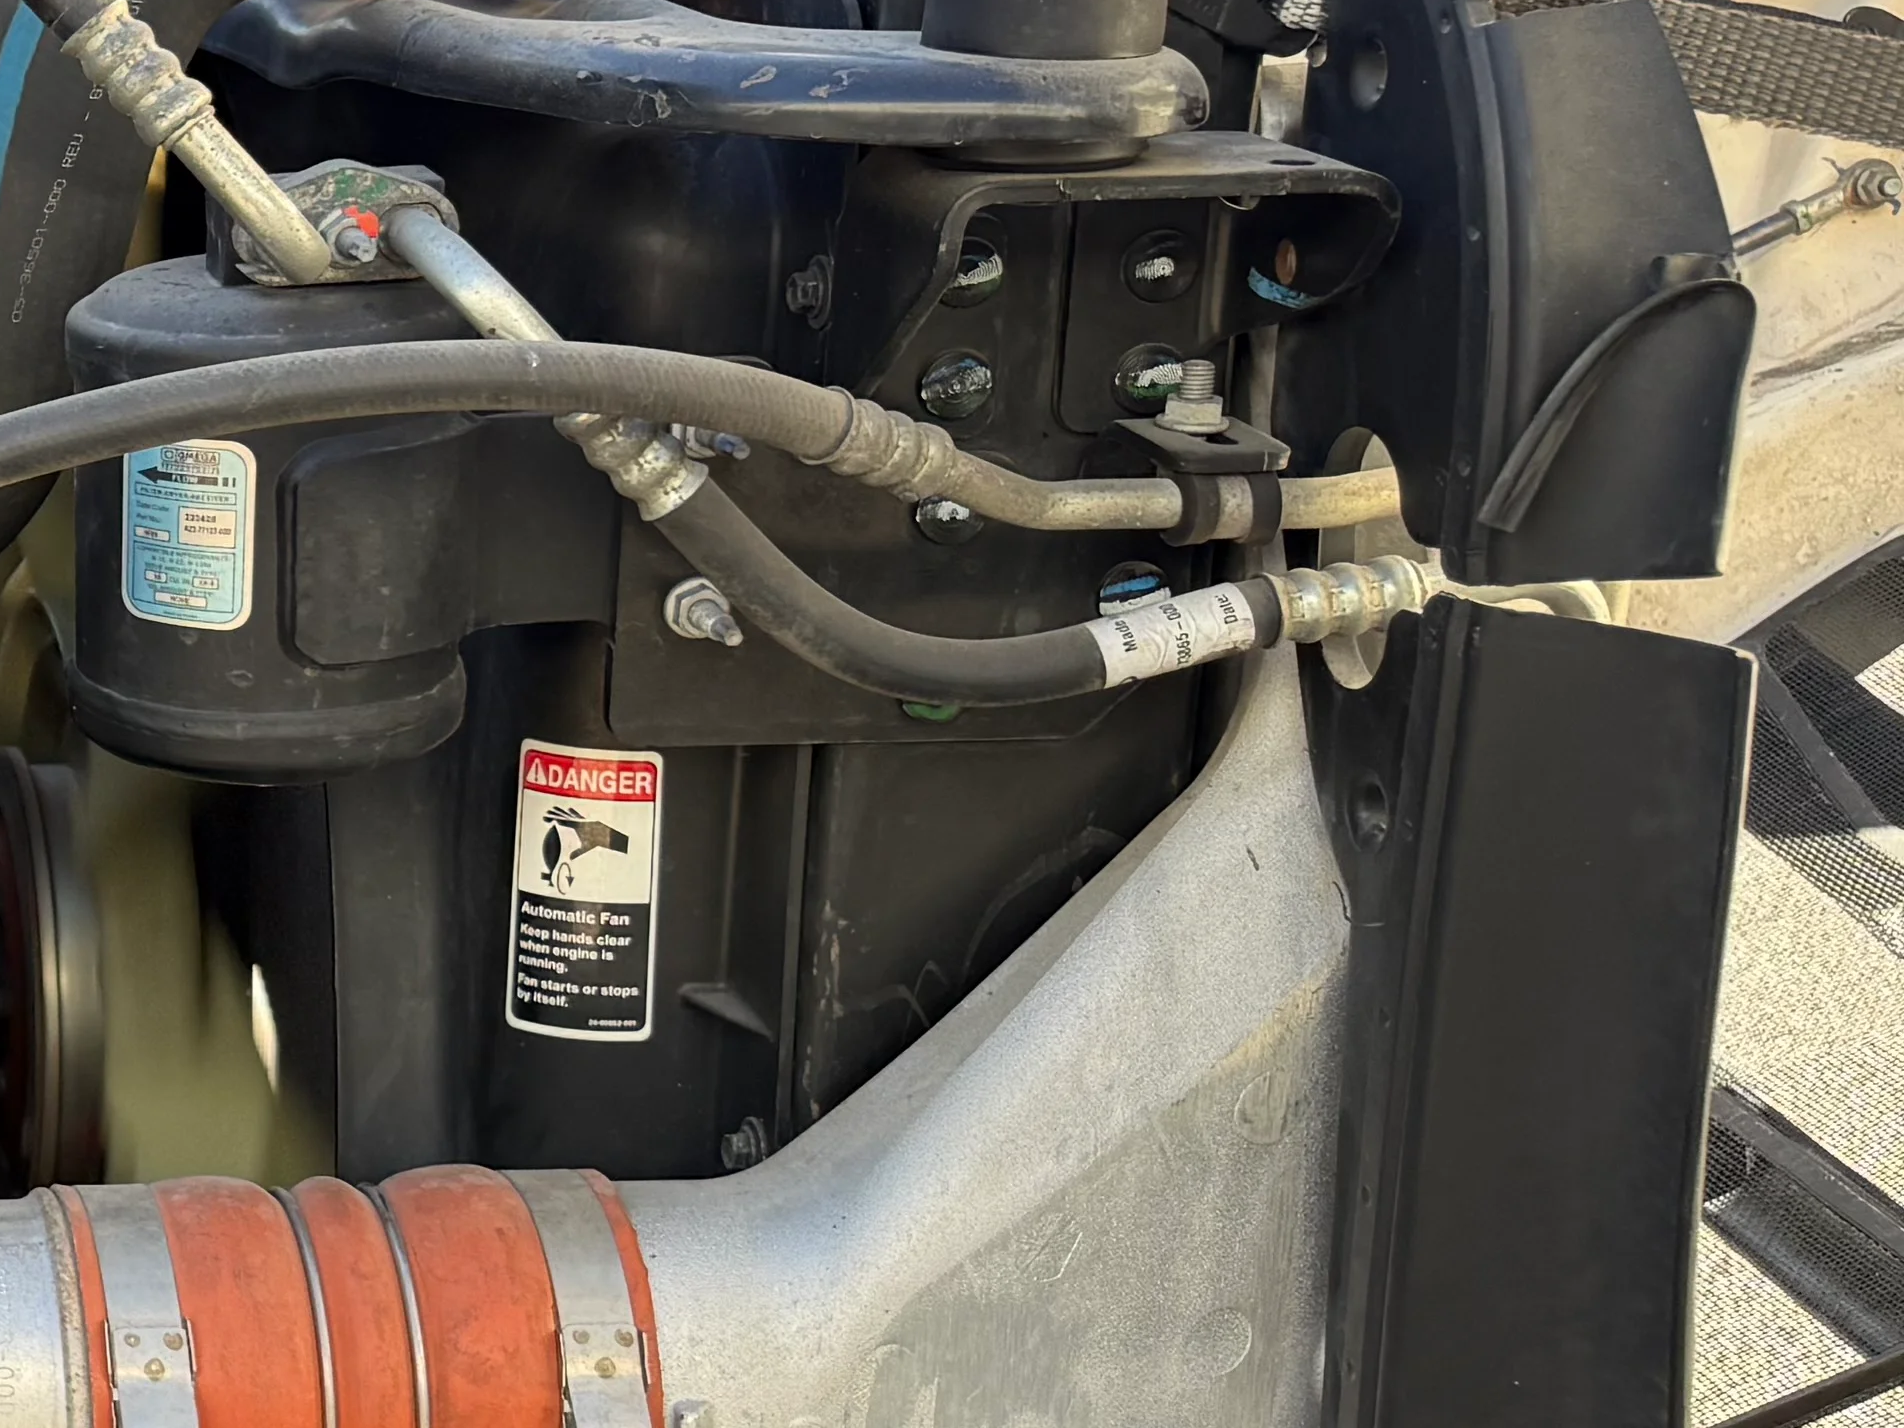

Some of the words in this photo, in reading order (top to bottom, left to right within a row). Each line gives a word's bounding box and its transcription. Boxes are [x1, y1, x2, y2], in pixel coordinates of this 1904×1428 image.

[1114, 620, 1137, 652] Made
[545, 763, 652, 796] DANGER
[521, 900, 596, 925] Automatic
[600, 912, 630, 926] Fan
[520, 922, 550, 941] Keep
[552, 929, 594, 945] hands
[596, 934, 632, 946] clear
[519, 939, 550, 954] when
[552, 946, 598, 961] engine
[601, 949, 614, 961] is
[518, 954, 568, 974] running.
[517, 972, 538, 987] Fan
[540, 980, 579, 994] starts
[582, 985, 597, 995] or
[600, 985, 639, 998] stops
[517, 987, 531, 1002] by
[533, 991, 569, 1007] itself.
